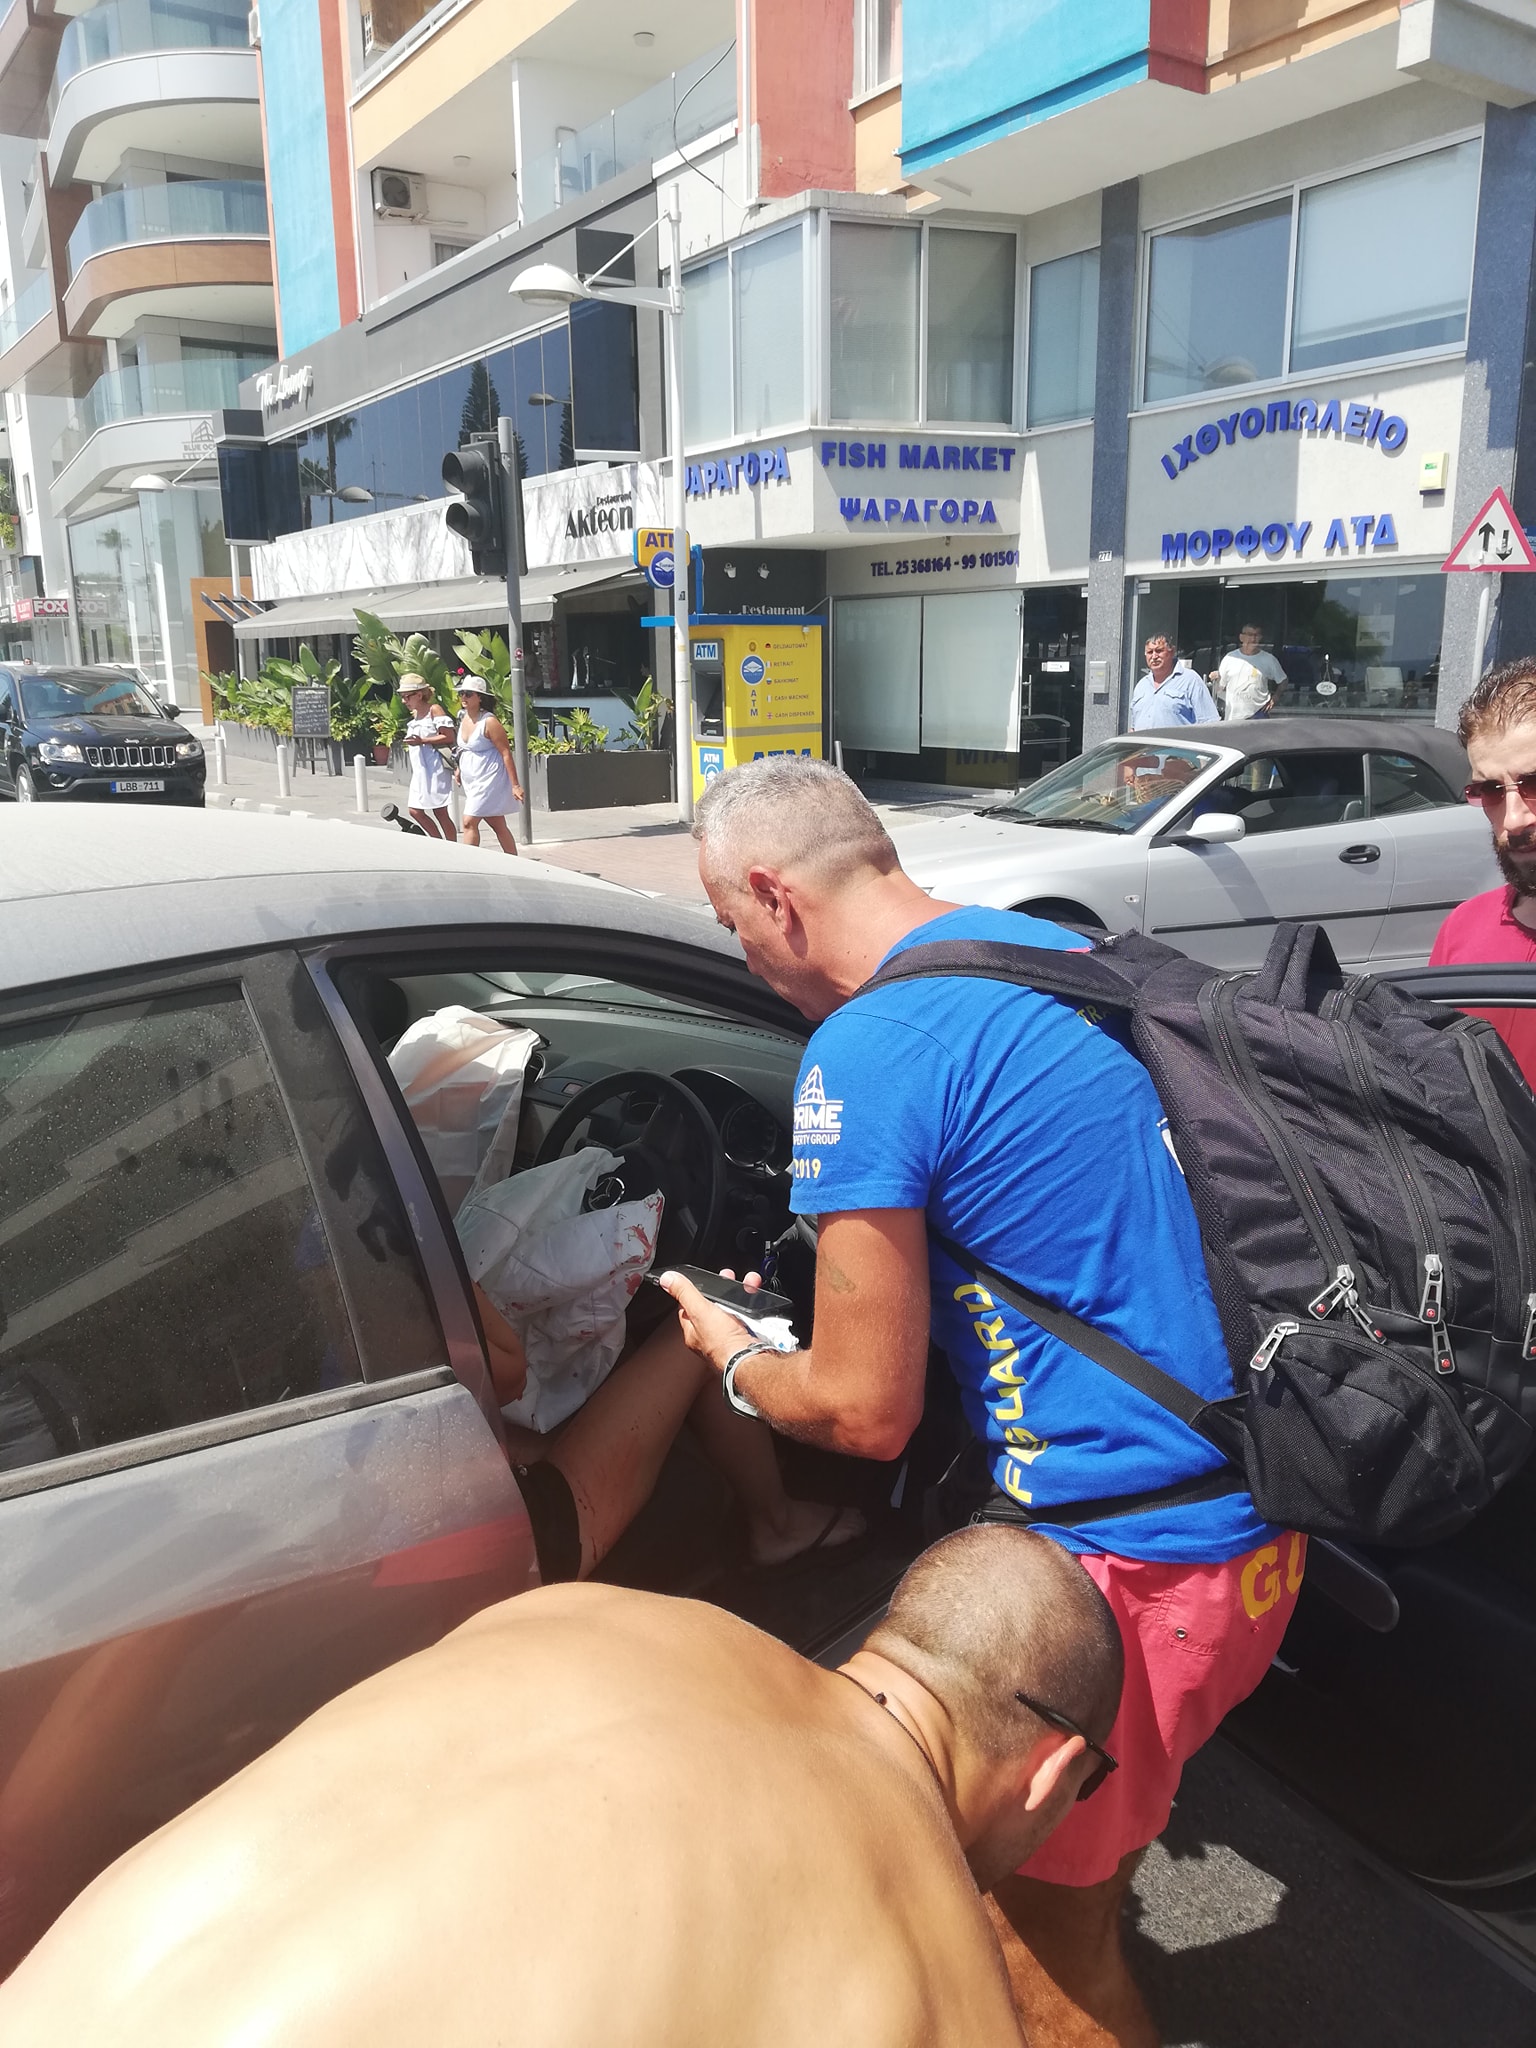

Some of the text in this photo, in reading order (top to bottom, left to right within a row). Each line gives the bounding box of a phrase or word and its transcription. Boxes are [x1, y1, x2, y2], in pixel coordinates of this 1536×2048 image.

[1161, 398, 1408, 480] ΙΧΘΥΟΠΩΛΕΙΟ
[821, 442, 1016, 472] FISH MARKET
[596, 491, 632, 506] Restaurant
[839, 497, 997, 524] ΨΑΡΑΓΟΡΑ
[564, 505, 634, 539] Akteon
[1162, 521, 1312, 561] ΜΟΡΦΟΥ
[871, 561, 894, 577] TEL.
[895, 561, 910, 575] 25
[910, 556, 951, 574] 368164
[961, 554, 976, 569] 99
[33, 600, 68, 613] FOX
[742, 604, 806, 616] Restaurant
[696, 644, 717, 659] ATM
[703, 753, 720, 763] ATM
[144, 781, 160, 791] 711
[811, 1133, 840, 1145] GROUP
[793, 1158, 821, 1179] 2019
